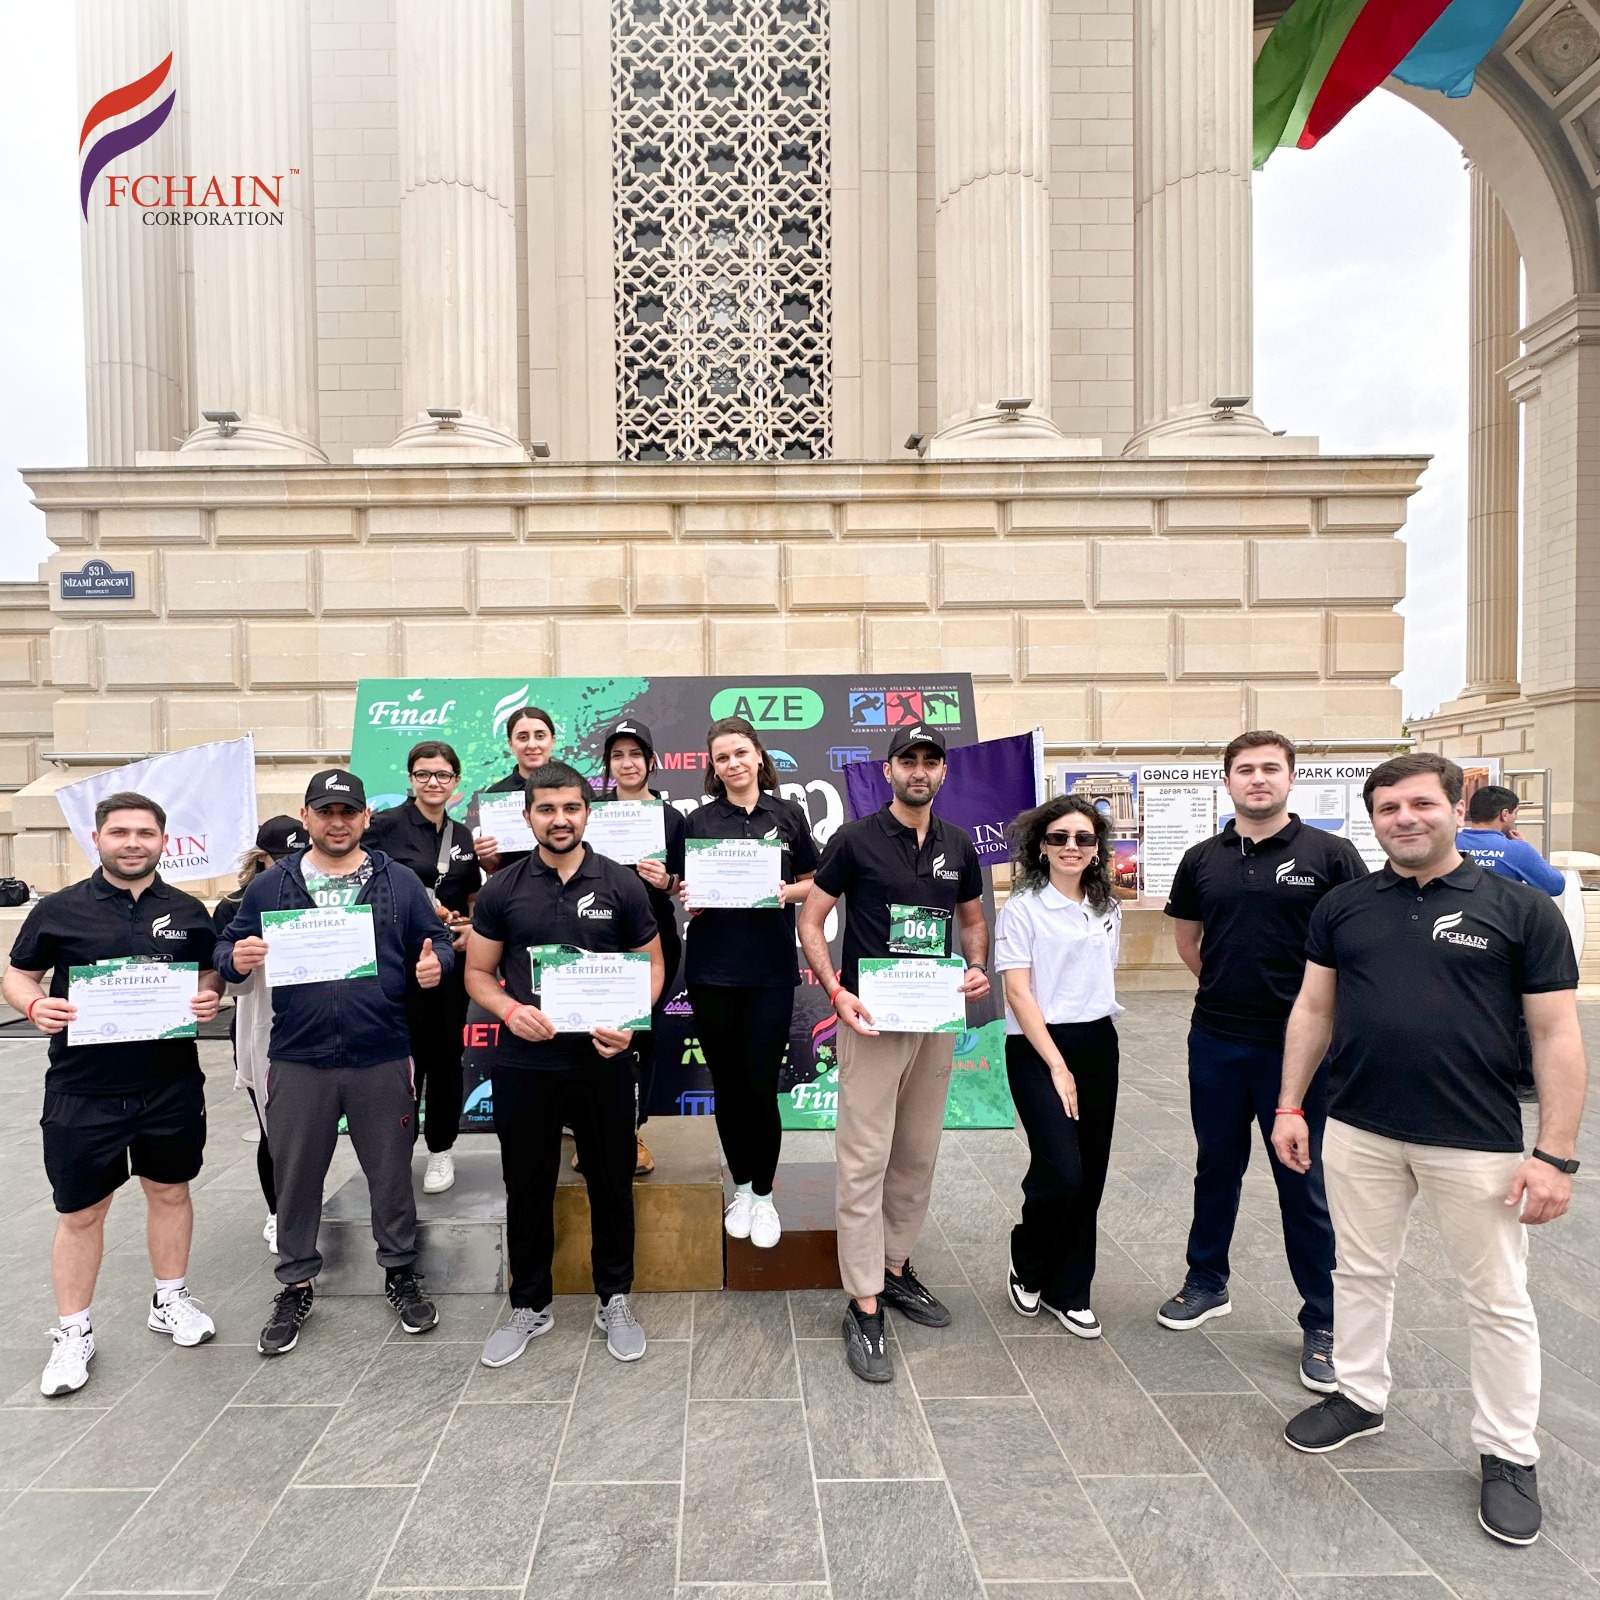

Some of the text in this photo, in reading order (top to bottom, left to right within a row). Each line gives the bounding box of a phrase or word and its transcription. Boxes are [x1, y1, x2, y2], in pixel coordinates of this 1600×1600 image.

[88, 566, 104, 576] 531
[64, 576, 129, 587] NİZAMİ GƏNCƏVİ
[368, 700, 456, 725] Final
[733, 696, 803, 722] AZE
[1143, 769, 1189, 780] GƏNCƏ
[1298, 768, 1332, 778] PARK
[593, 810, 642, 819] SERTİFİKAT
[707, 849, 758, 857] SERTİFİKAT
[1280, 875, 1315, 883] FCHAIN
[315, 889, 353, 907] 067
[289, 919, 347, 930] SERTİFİKAT
[904, 919, 937, 941] 064
[1439, 930, 1489, 946] FCHAIN
[566, 964, 624, 974] SERTİFİKAT
[883, 970, 937, 979] SERTİFİKAT
[100, 976, 168, 986] SERTİFİKAT
